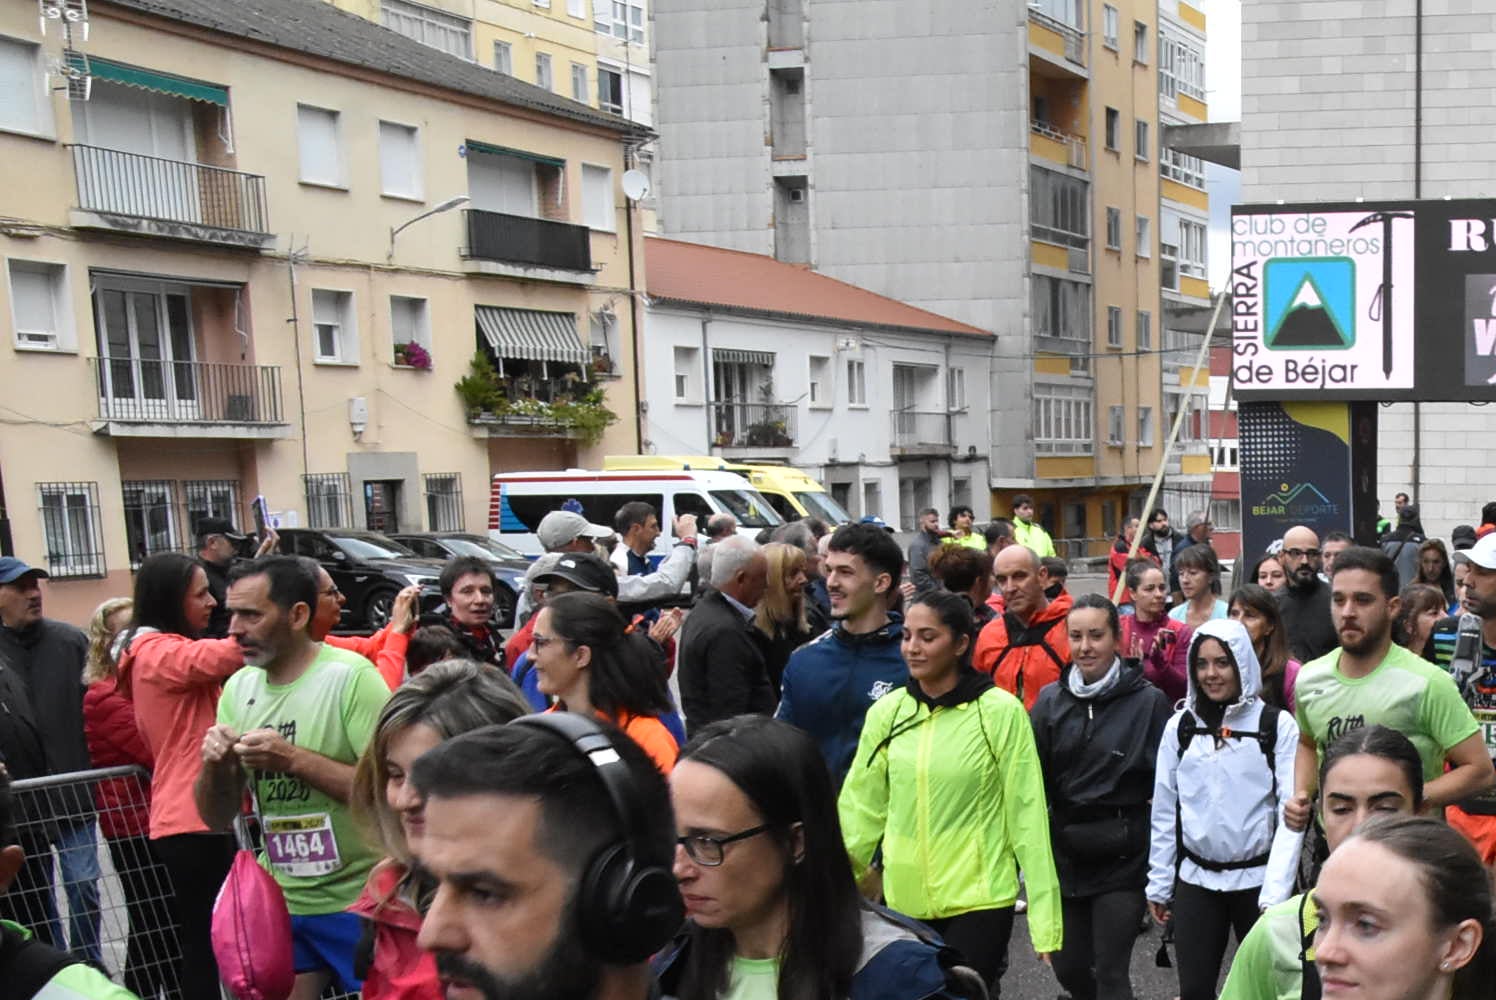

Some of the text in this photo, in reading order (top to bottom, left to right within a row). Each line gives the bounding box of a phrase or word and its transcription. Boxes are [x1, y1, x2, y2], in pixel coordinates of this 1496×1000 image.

[1233, 214, 1328, 236] club de
[1233, 234, 1381, 257] montañeros
[1233, 260, 1259, 357] SIERRA
[1233, 356, 1359, 390] de Béjar
[272, 831, 325, 858] 1464
